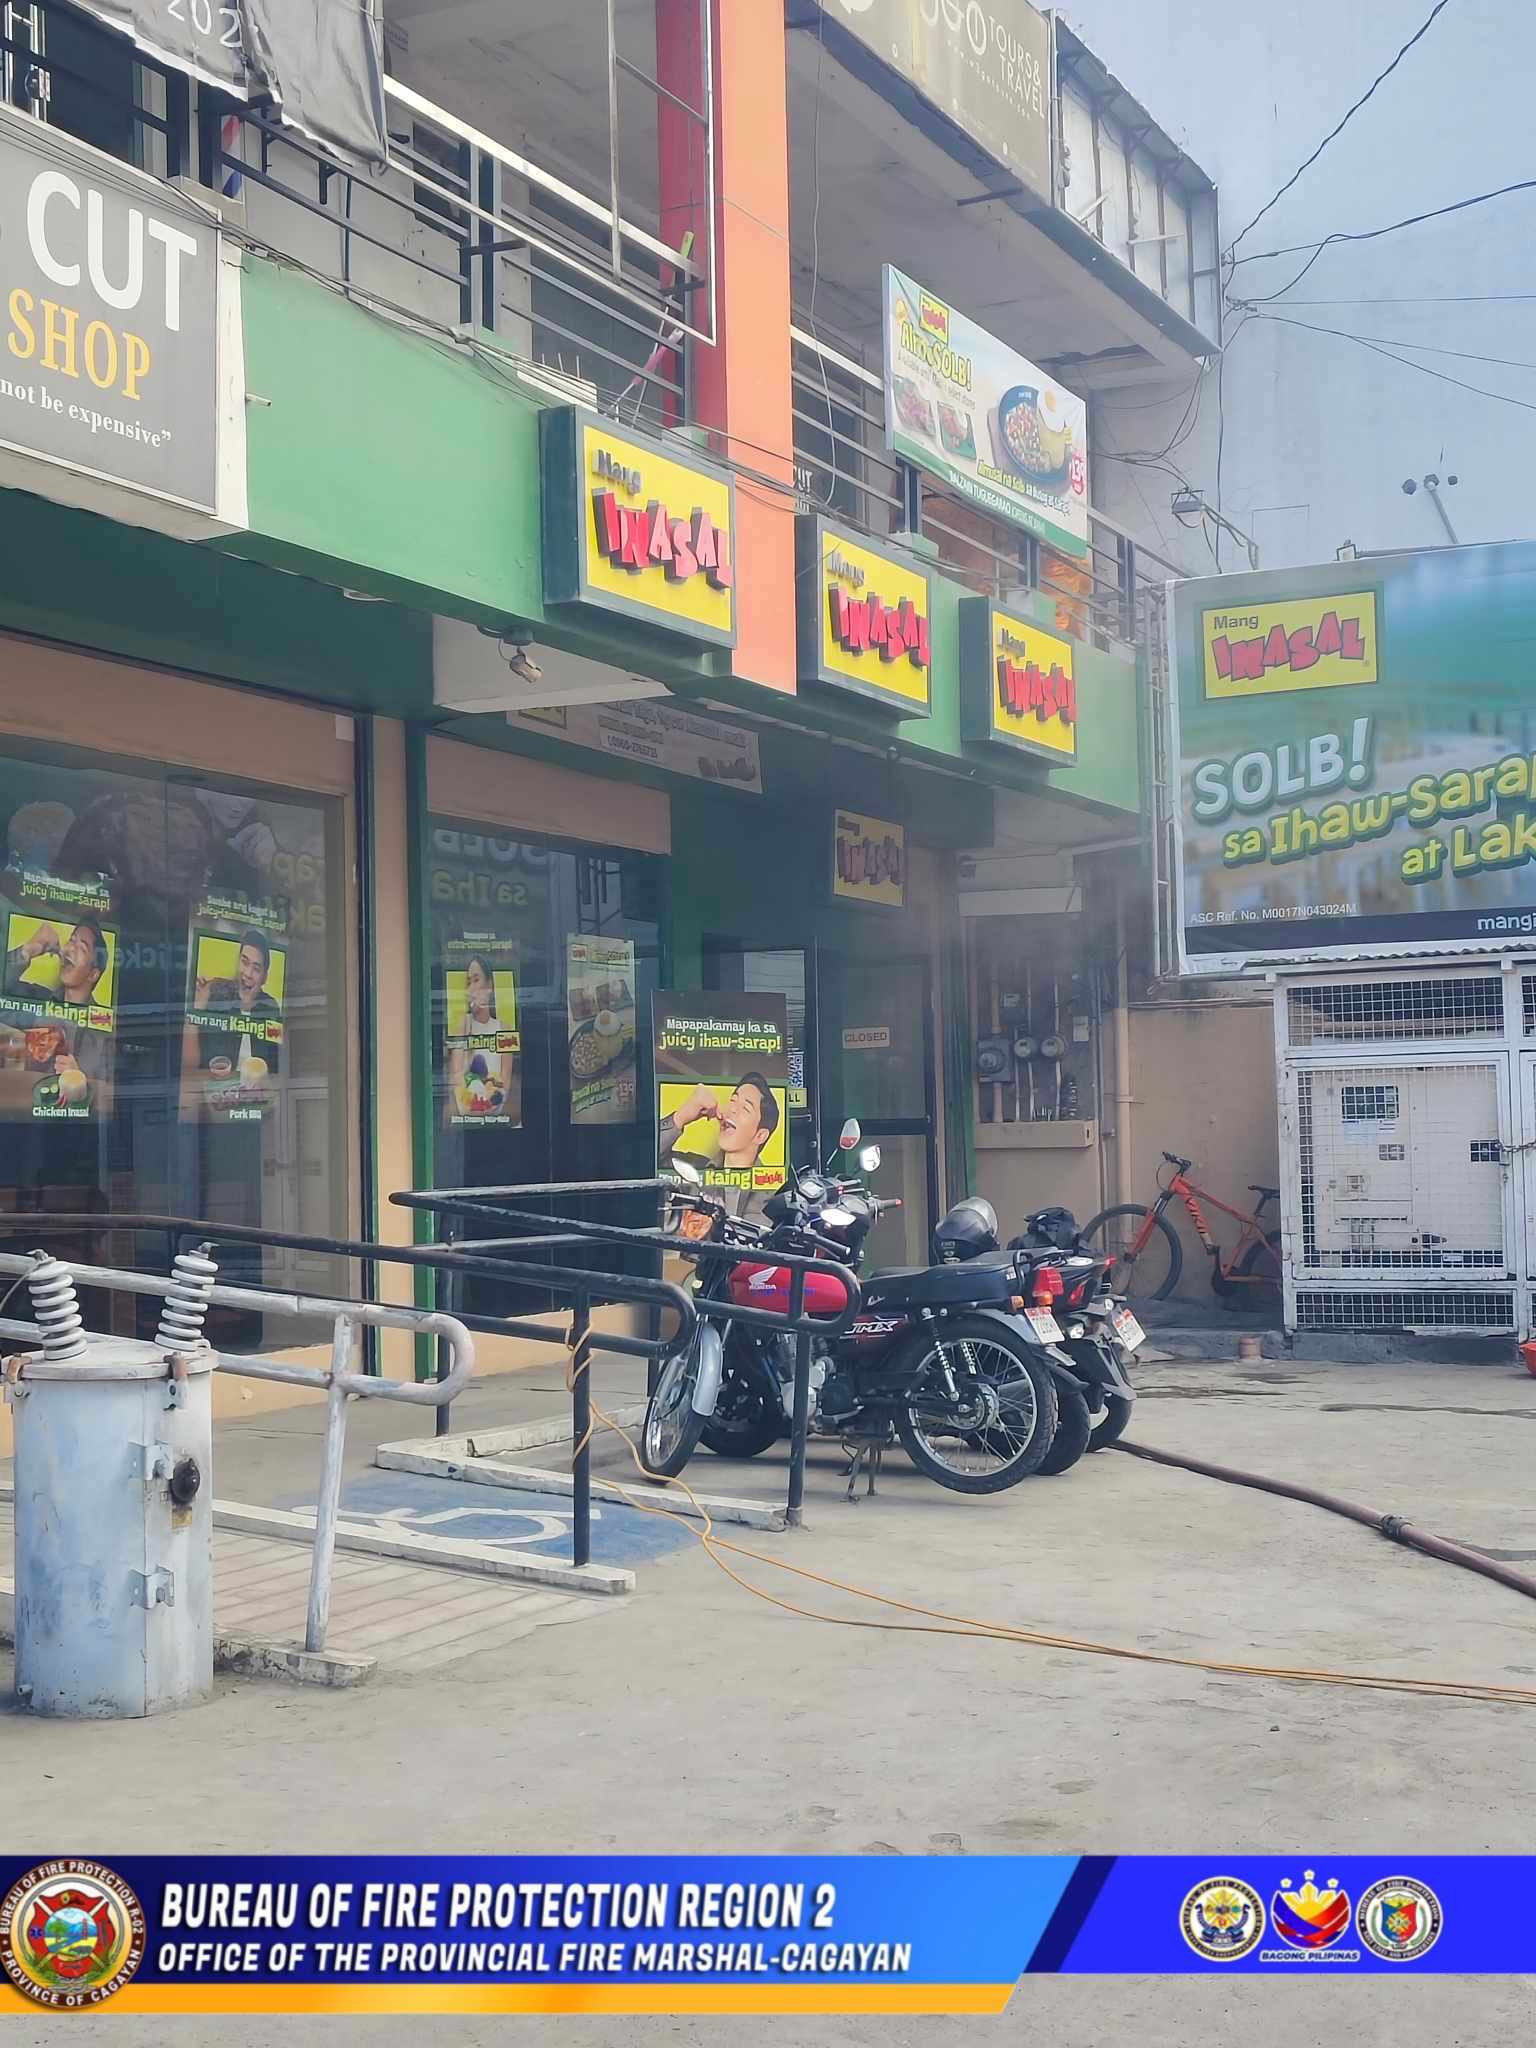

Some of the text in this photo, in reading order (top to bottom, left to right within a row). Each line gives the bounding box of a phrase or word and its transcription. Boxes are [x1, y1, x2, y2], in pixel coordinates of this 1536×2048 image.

[1000, 54, 1045, 119] TRAVEL
[27, 171, 198, 331] CUT
[7, 287, 151, 400] SHOP
[41, 386, 63, 414] be
[593, 449, 642, 496] Mang
[1213, 614, 1259, 630] Mang
[1211, 611, 1366, 682] INASAL
[1195, 716, 1370, 817] SOLB!
[1223, 831, 1262, 861] sa
[1401, 812, 1536, 876] at Lak
[20, 881, 47, 899] juicy
[1190, 912, 1215, 923] ASC
[1217, 910, 1238, 922] Ref.
[1241, 909, 1259, 921] No.
[22, 1003, 43, 1017] ang
[46, 1000, 88, 1028] Kaing
[208, 1017, 229, 1032] ang
[230, 1015, 266, 1040] Kaing
[666, 1018, 776, 1035] Mapapakamay ka sa
[659, 1032, 780, 1054] juicy ihaw-sarap!
[845, 1031, 888, 1044] CLOSED
[704, 1168, 752, 1190] Kaing
